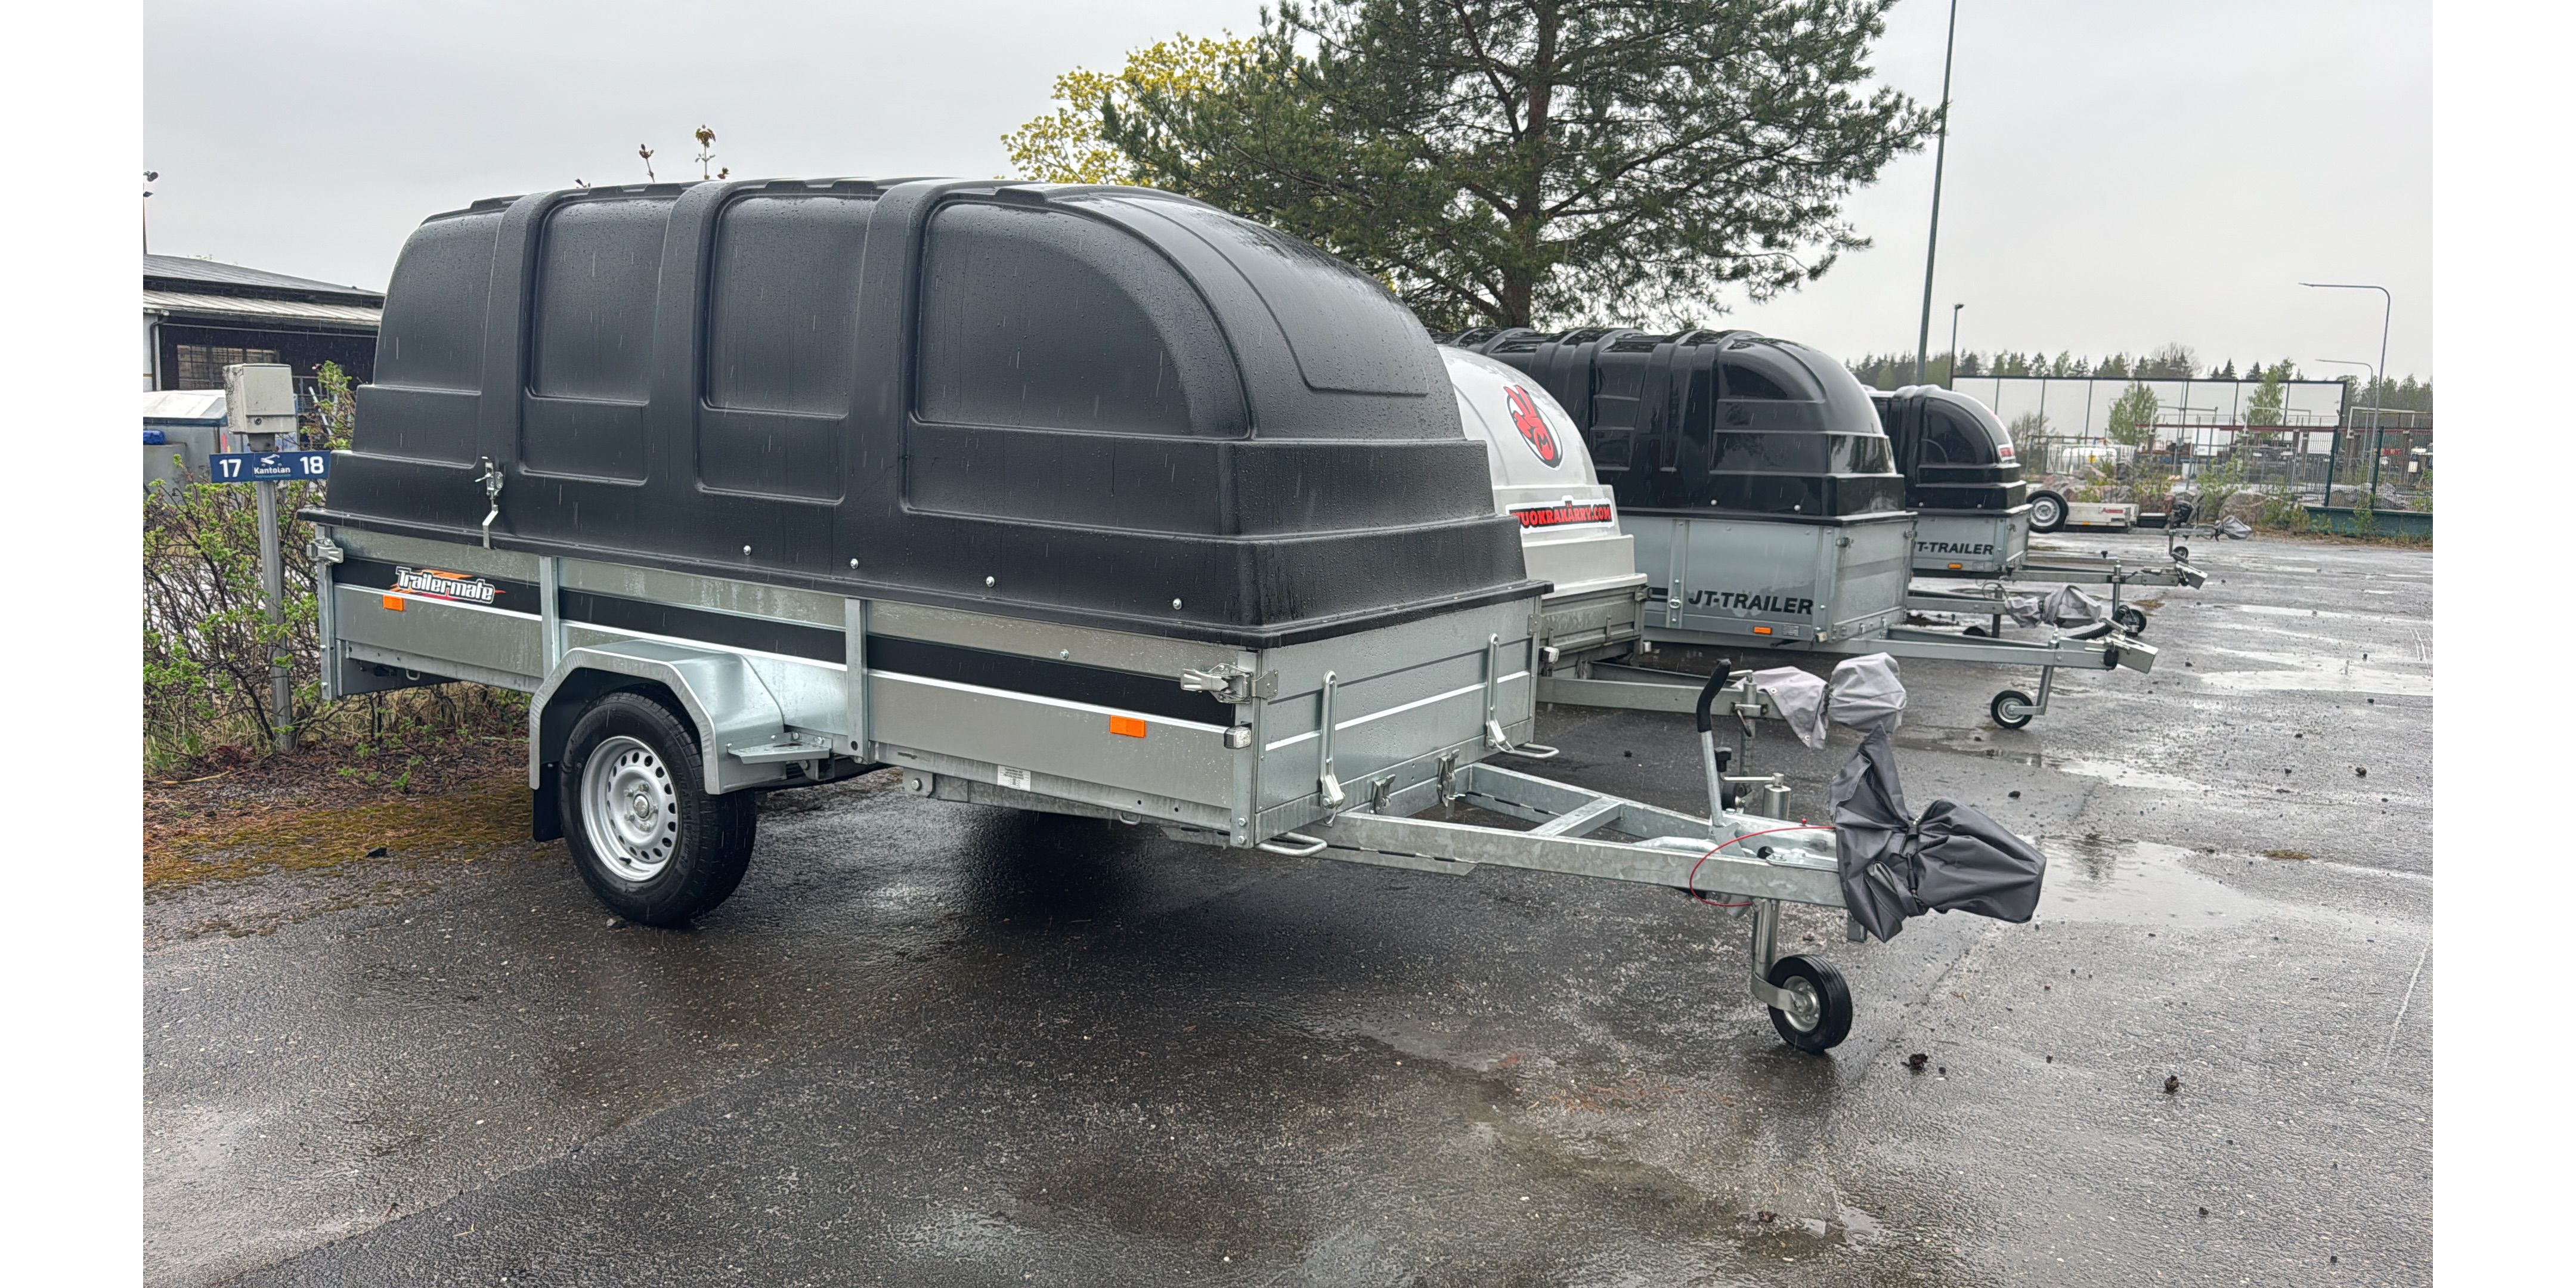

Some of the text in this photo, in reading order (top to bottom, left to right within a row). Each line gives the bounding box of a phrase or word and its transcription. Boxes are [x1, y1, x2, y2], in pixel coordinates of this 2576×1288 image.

[219, 459, 242, 478] 17
[254, 466, 291, 475] Kantolan
[300, 456, 324, 475] 18
[1914, 541, 1994, 555] T-TRAILER
[397, 568, 494, 601] Trailermate
[1688, 590, 1813, 615] JT-TRAILER
